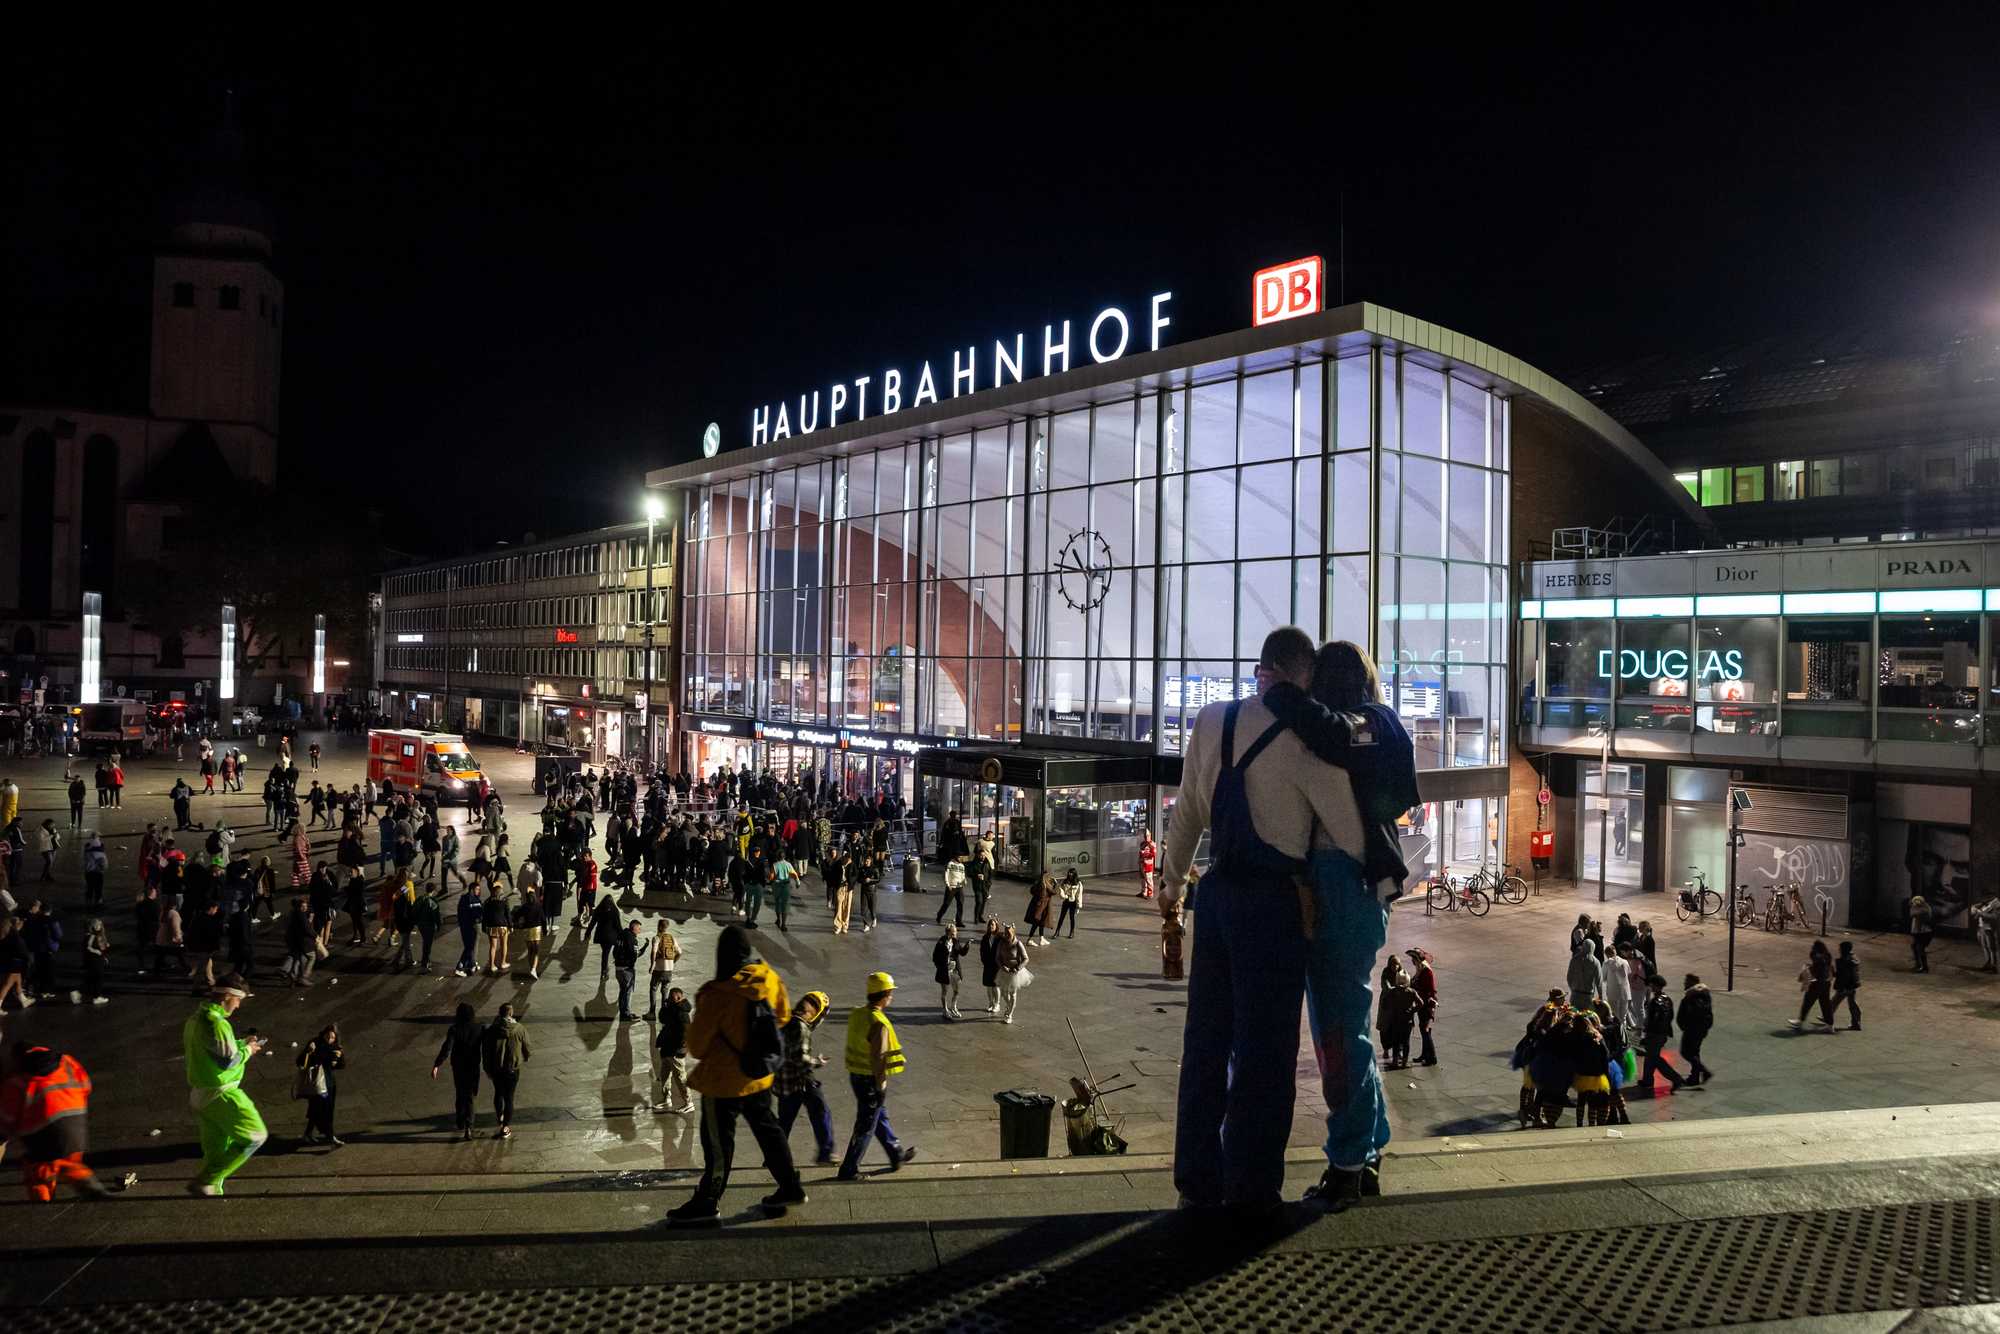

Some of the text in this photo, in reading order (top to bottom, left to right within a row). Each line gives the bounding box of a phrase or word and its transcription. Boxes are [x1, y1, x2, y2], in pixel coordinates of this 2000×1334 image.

[1261, 269, 1311, 318] DB
[752, 291, 1171, 447] HAUPTBAHNHOF
[705, 426, 718, 455] S
[1715, 566, 1758, 582] Dior
[1887, 559, 1971, 575] PRADA
[1599, 649, 1743, 679] DOUGAS
[1055, 713, 1081, 721] Leonidas
[850, 735, 888, 751] NetCologne
[1051, 855, 1077, 865] Kamps
